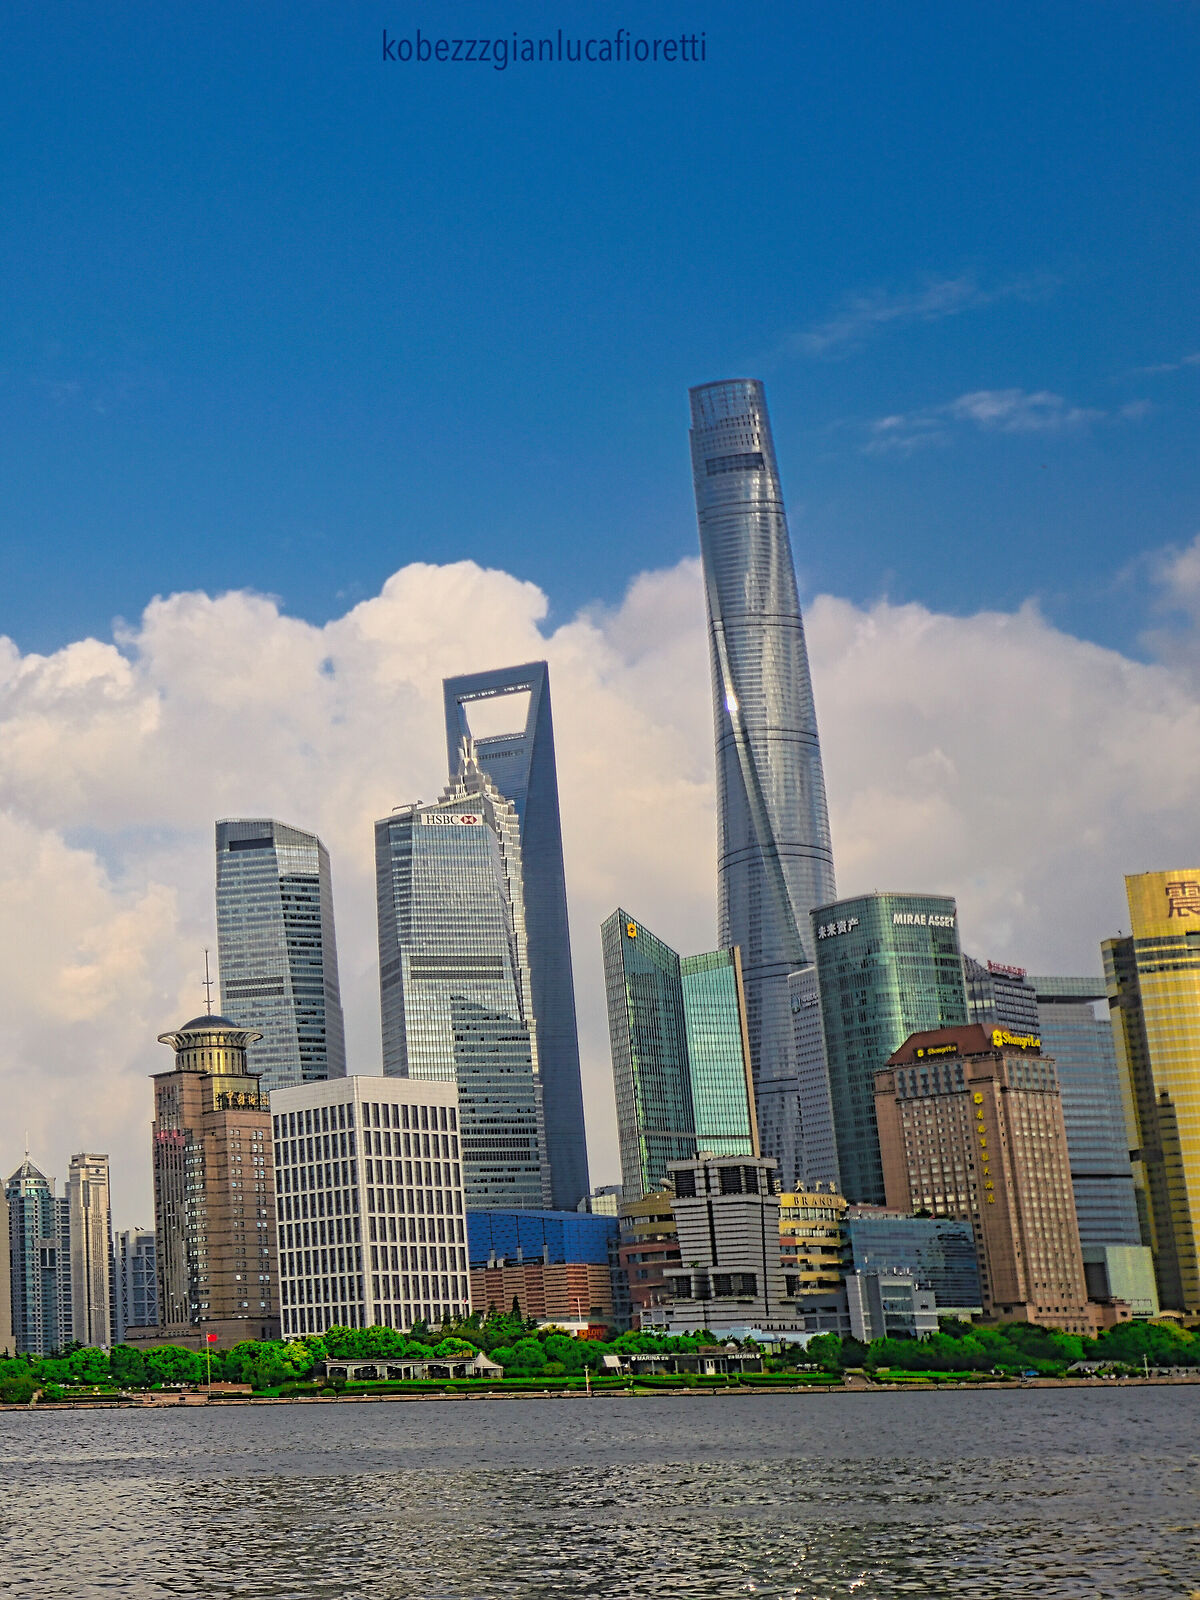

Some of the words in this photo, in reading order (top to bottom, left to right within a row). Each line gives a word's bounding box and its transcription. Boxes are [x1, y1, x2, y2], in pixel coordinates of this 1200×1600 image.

[426, 815, 459, 825] HSBC
[893, 913, 926, 926] MIRAE
[928, 915, 955, 928] ASSET
[818, 918, 860, 939] 未来资产
